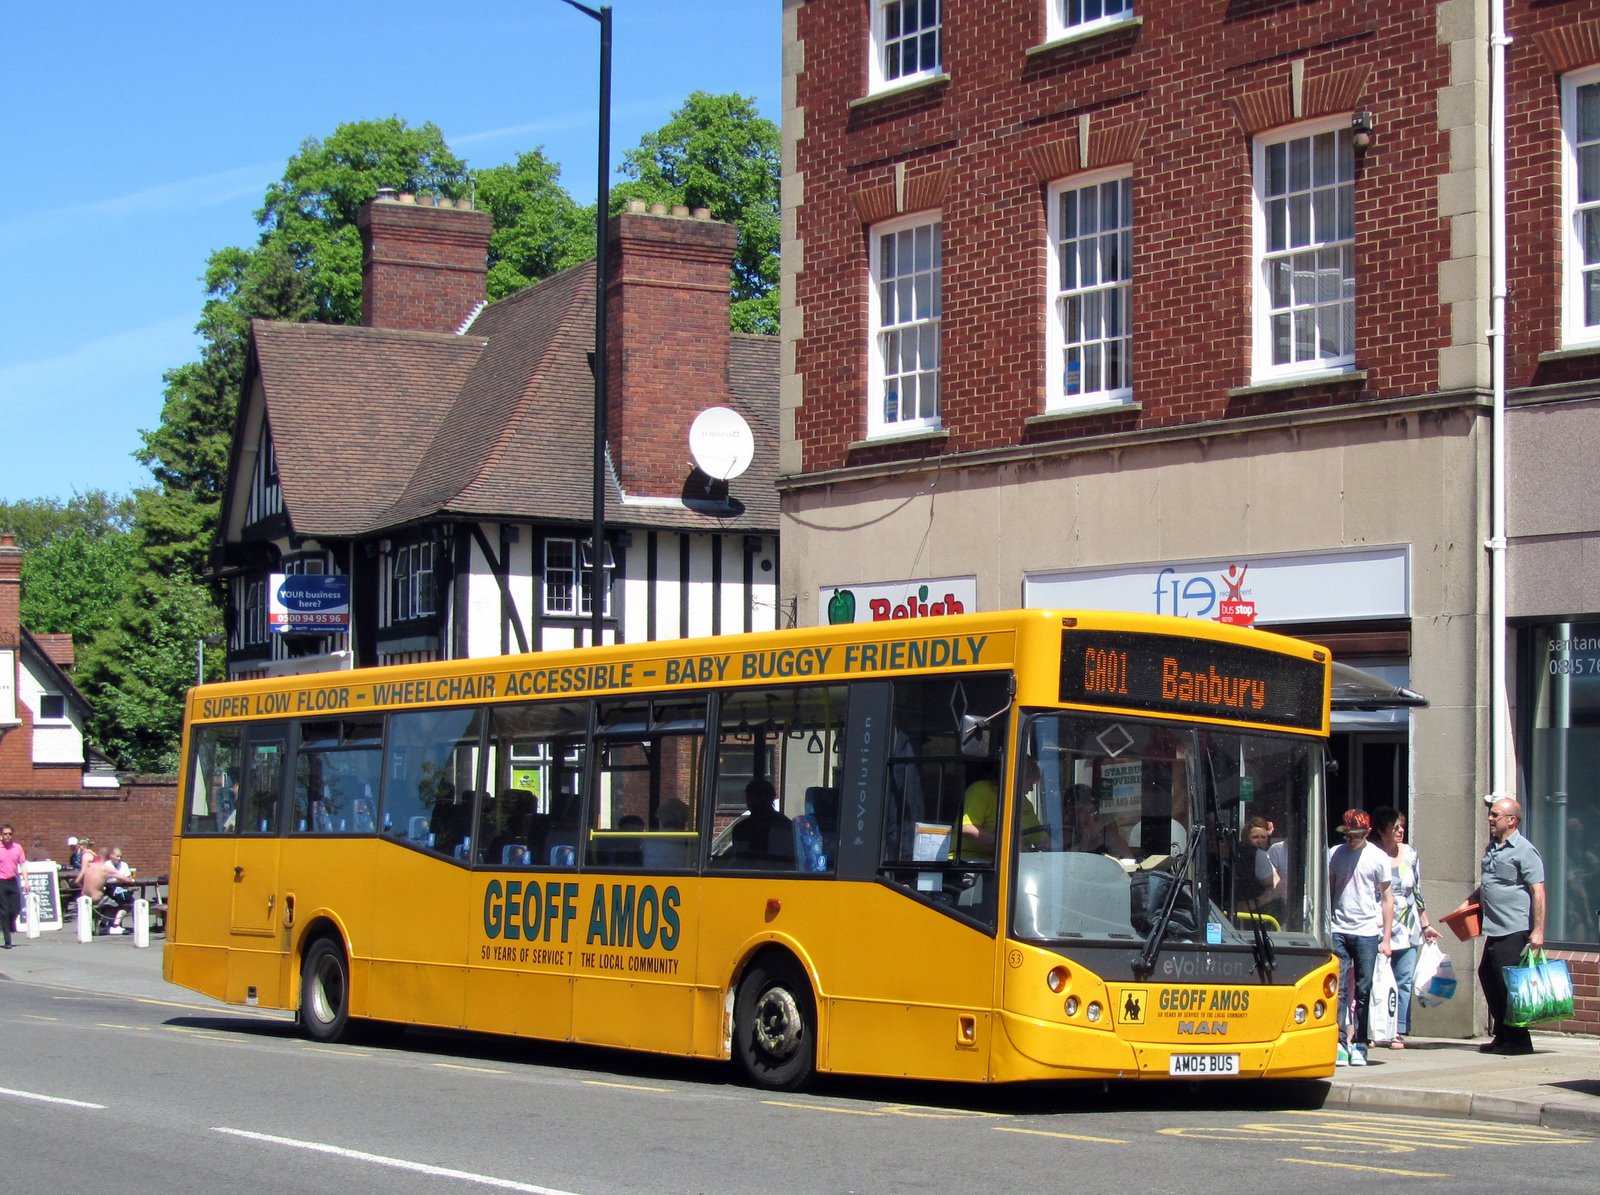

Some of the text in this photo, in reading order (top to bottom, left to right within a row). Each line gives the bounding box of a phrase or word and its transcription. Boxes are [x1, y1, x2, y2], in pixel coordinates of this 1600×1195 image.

[277, 614, 341, 622] 0500 94 95 96
[1221, 604, 1253, 617] bus stop
[1549, 637, 1600, 651] santan
[1549, 659, 1583, 675] 0845
[203, 698, 249, 719] SUPER
[255, 693, 291, 715] LOW
[297, 688, 349, 711] FLOOR
[372, 676, 495, 706] WHEELCHAIR
[504, 663, 634, 697] ACCESSIBLE
[665, 655, 731, 686] BABY
[741, 648, 832, 679] BUGGY
[843, 635, 988, 673] FRIENDLY
[1162, 656, 1265, 710] Banbury
[483, 879, 681, 951] GEOFF AMOS
[481, 945, 490, 960] 50
[493, 946, 517, 962] YEARS
[520, 948, 530, 963] OF
[532, 949, 564, 965] SERVICE
[581, 952, 596, 968] THE
[599, 954, 625, 970] LOCAL
[628, 956, 680, 974] COMMUNITY
[1159, 988, 1250, 1011] GEOFF AMOS
[1177, 1020, 1228, 1035] MAN
[1209, 1057, 1233, 1072] BUS
